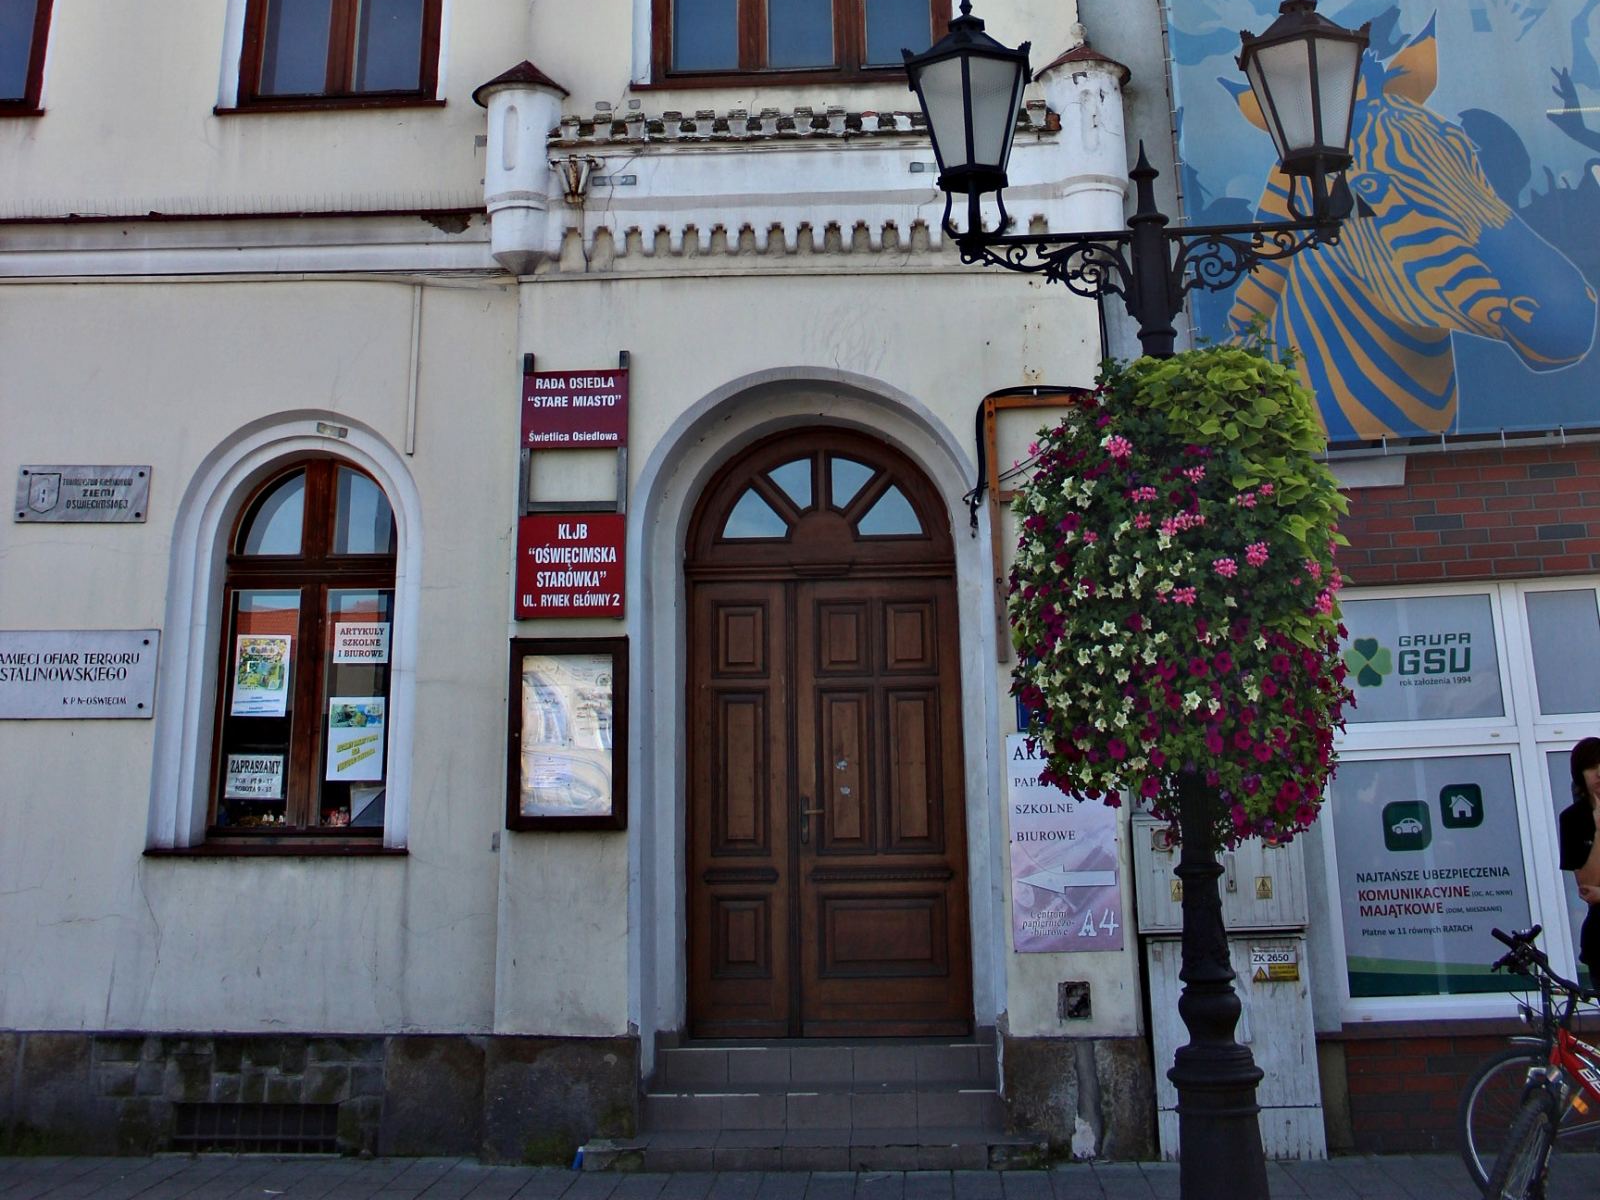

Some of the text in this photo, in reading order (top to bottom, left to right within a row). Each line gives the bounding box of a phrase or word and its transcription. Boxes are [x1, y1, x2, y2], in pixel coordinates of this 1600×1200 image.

[536, 377, 614, 389] RADA OSIEDLA
[529, 430, 618, 442] Świetlica Osiedlowa
[523, 591, 620, 607] UL. RYNEK GŁÓWNY 2
[1399, 633, 1471, 647] GRUPA
[44, 653, 79, 665] OFIAR
[84, 653, 140, 664] TERRORU
[1398, 647, 1471, 675] GSU
[0, 667, 127, 681] STALINOWSKIEGO
[1453, 676, 1471, 684] 1994
[230, 760, 280, 774] ZAPRASZAMY
[1016, 804, 1074, 814] SZKOLNE
[1016, 831, 1076, 842] BIUROWE
[1356, 866, 1510, 883] NAJTAŃSZE UBEZPIECZENIA
[1358, 886, 1470, 901] KOMUNIKACYJNE
[1360, 903, 1443, 918] MAJĄTKOWE
[1078, 908, 1119, 936] A4
[1408, 926, 1441, 935] równych
